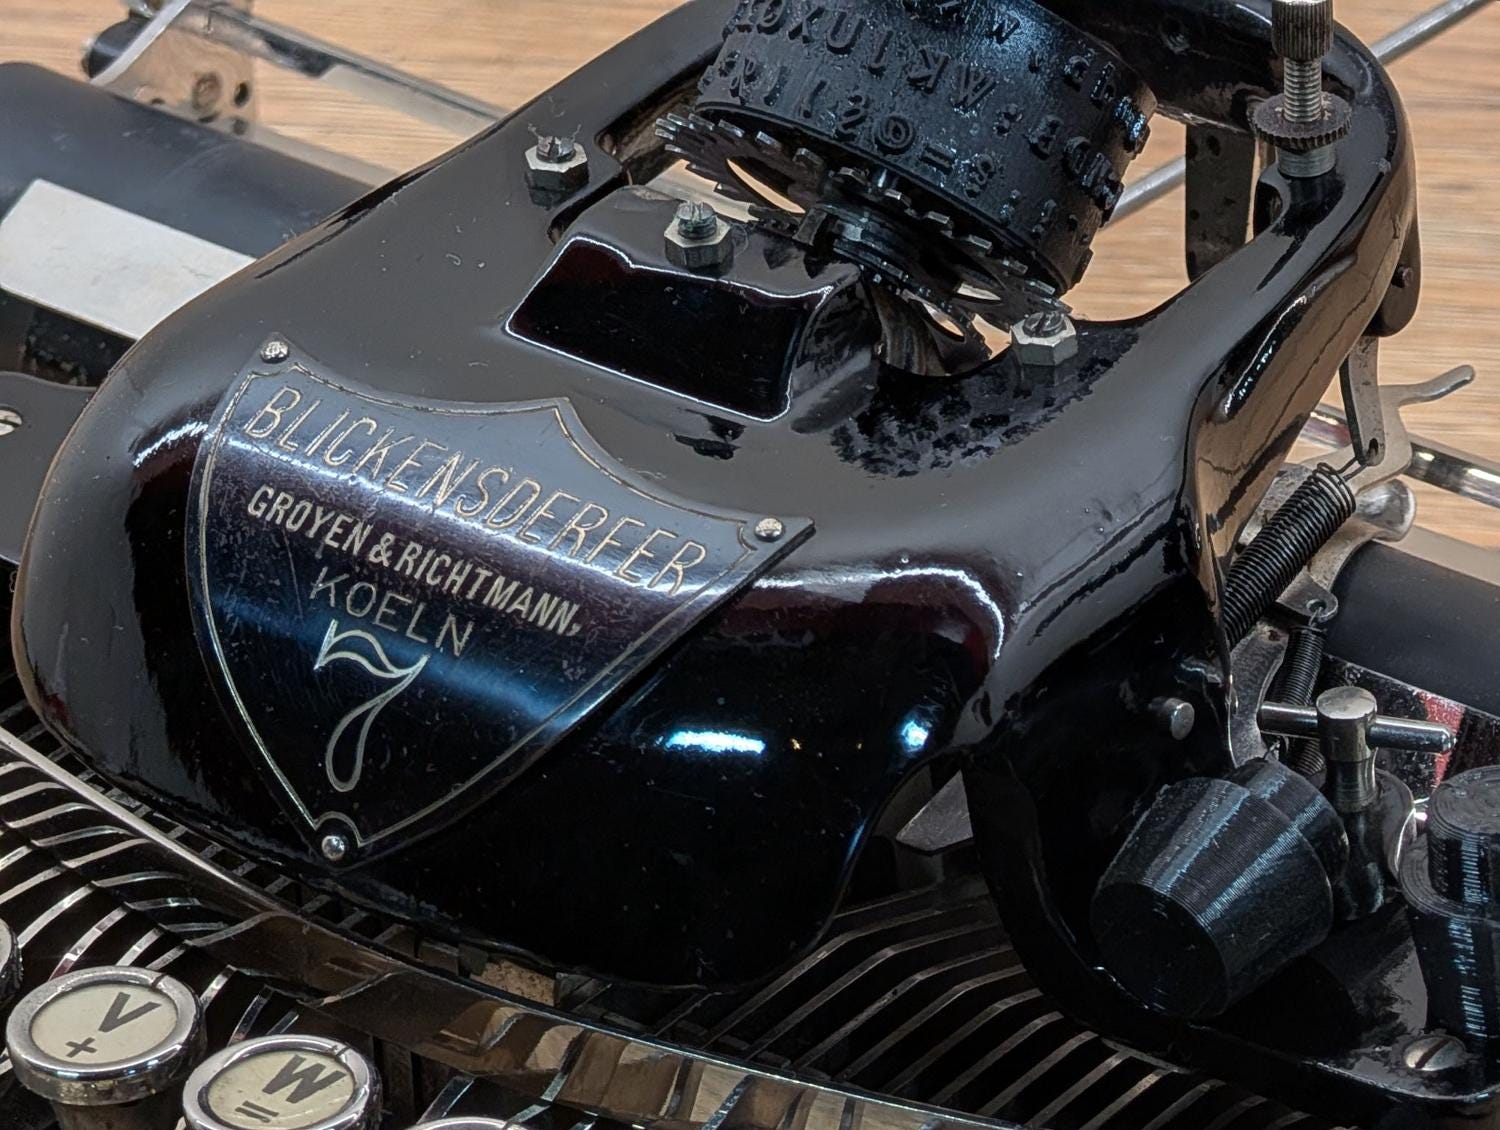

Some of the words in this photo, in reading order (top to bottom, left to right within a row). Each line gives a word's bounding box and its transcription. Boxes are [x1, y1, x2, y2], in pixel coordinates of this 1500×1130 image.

[242, 385, 707, 597] BLICKENSDERFER
[247, 484, 371, 556] GROYEN
[370, 532, 392, 565] &
[393, 544, 582, 636] RICHTMANN,
[308, 566, 475, 657] KOELN
[314, 620, 431, 792] 7
[97, 991, 160, 1034] V
[262, 1054, 346, 1105] W
